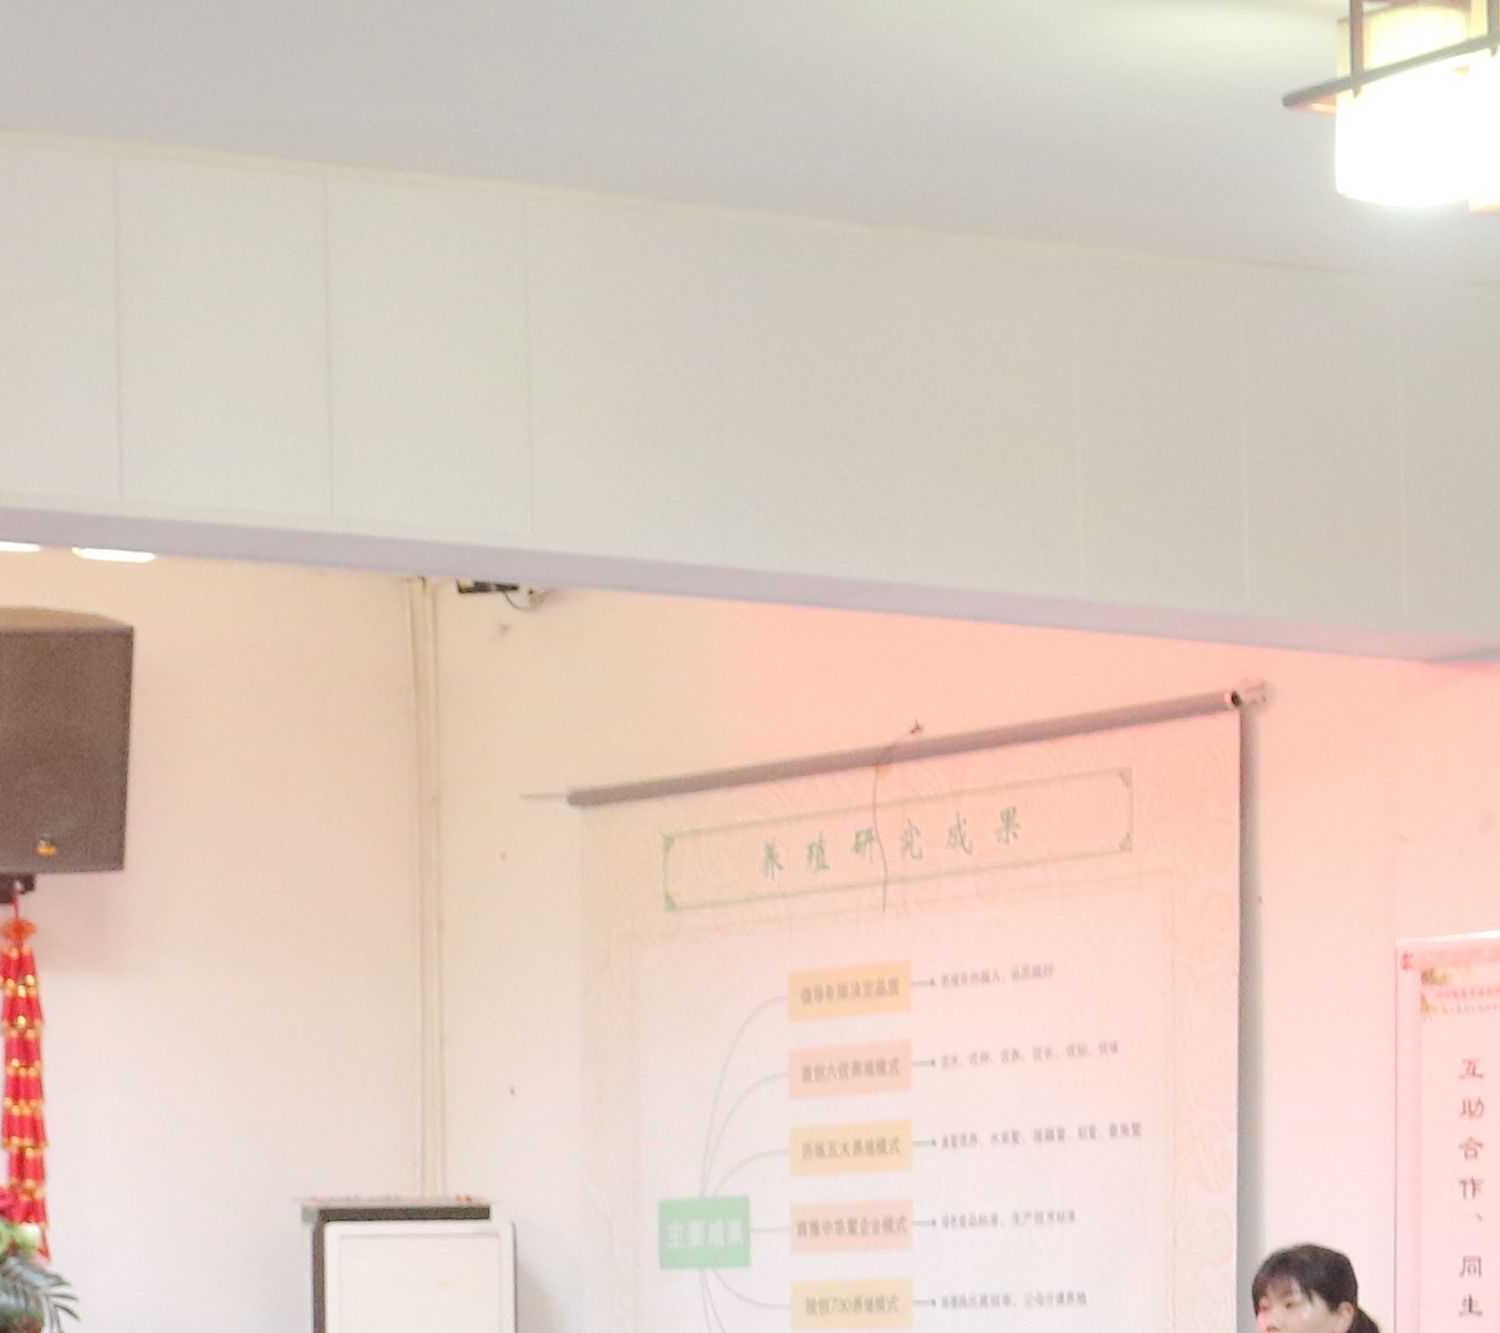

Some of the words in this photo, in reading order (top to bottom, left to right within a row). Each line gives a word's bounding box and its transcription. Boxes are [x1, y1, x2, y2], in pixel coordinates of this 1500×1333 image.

[759, 806, 1022, 880] 养殖研究成果
